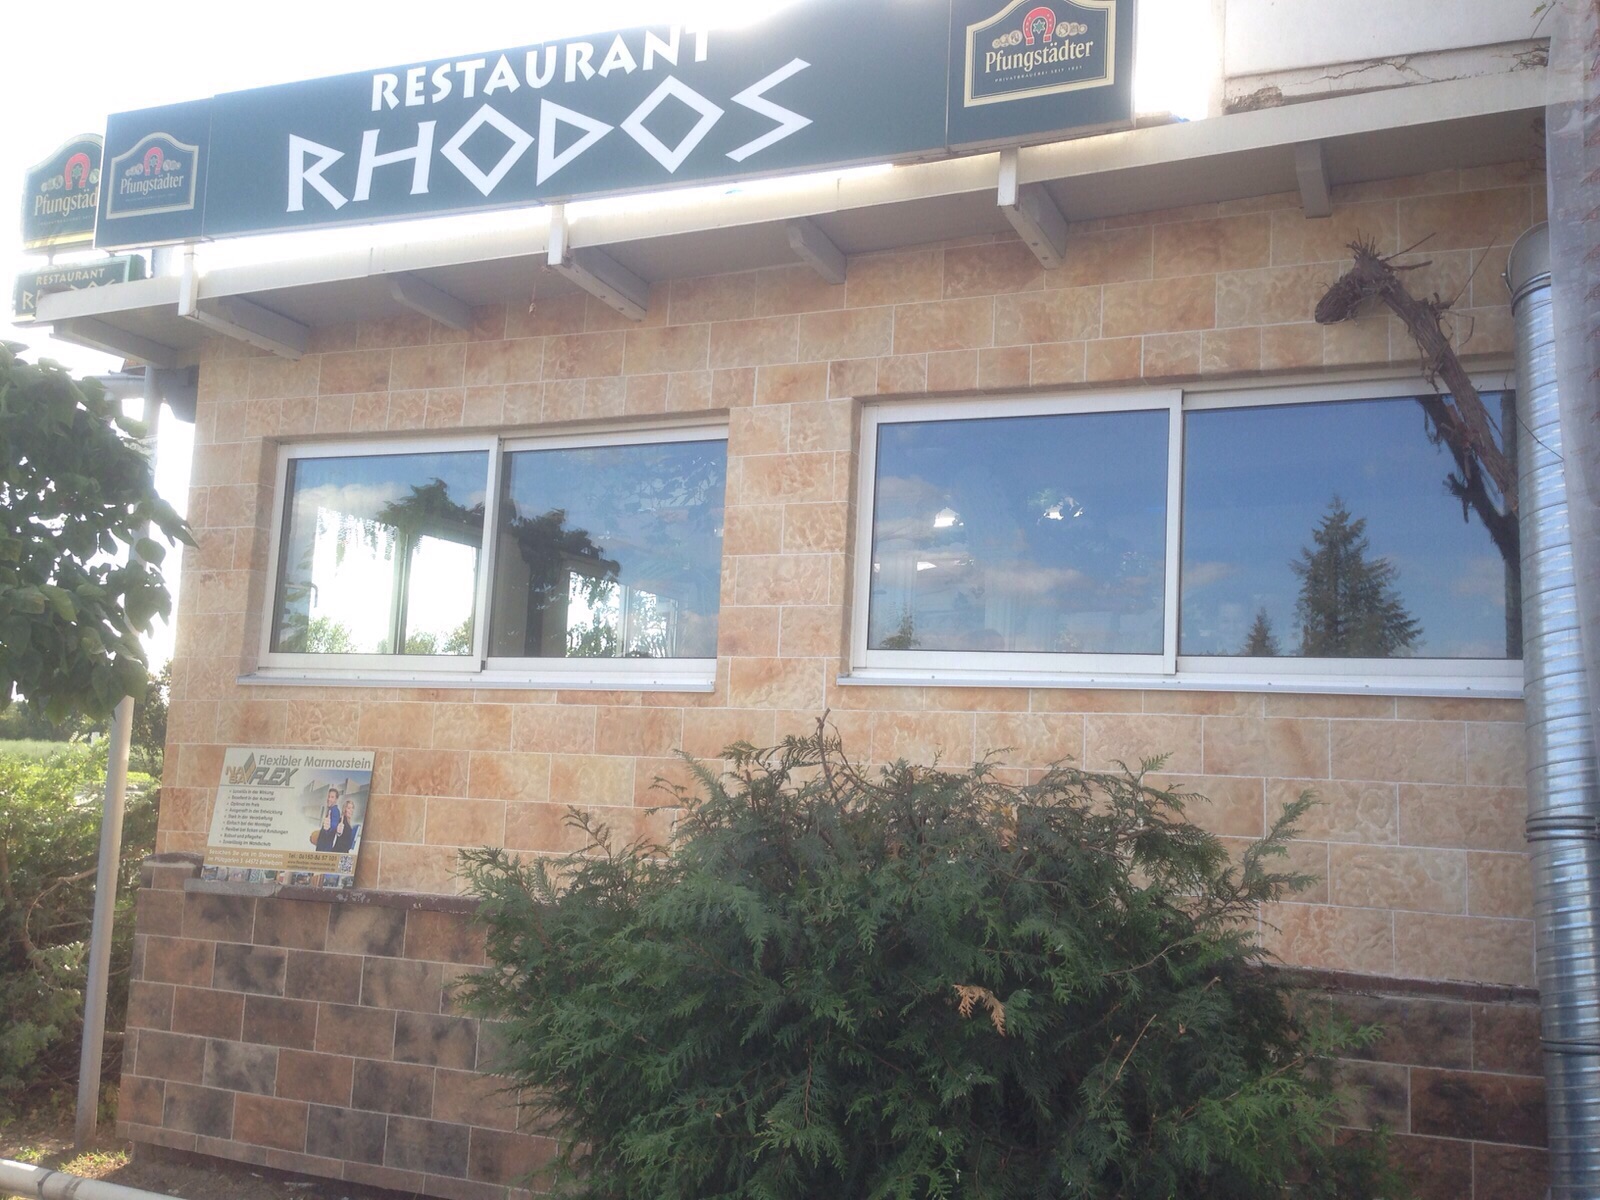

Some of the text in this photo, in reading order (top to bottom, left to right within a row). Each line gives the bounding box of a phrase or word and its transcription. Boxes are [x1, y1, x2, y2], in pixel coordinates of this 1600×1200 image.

[371, 24, 709, 112] RESTAURANT
[984, 39, 1094, 74] Pfungstädter
[286, 57, 814, 214] RHODOS
[119, 173, 185, 197] Pfungstädter
[36, 268, 105, 286] RESTAURANT
[258, 754, 372, 769] Flexibler Marmorstein
[248, 767, 299, 786] FLEX
